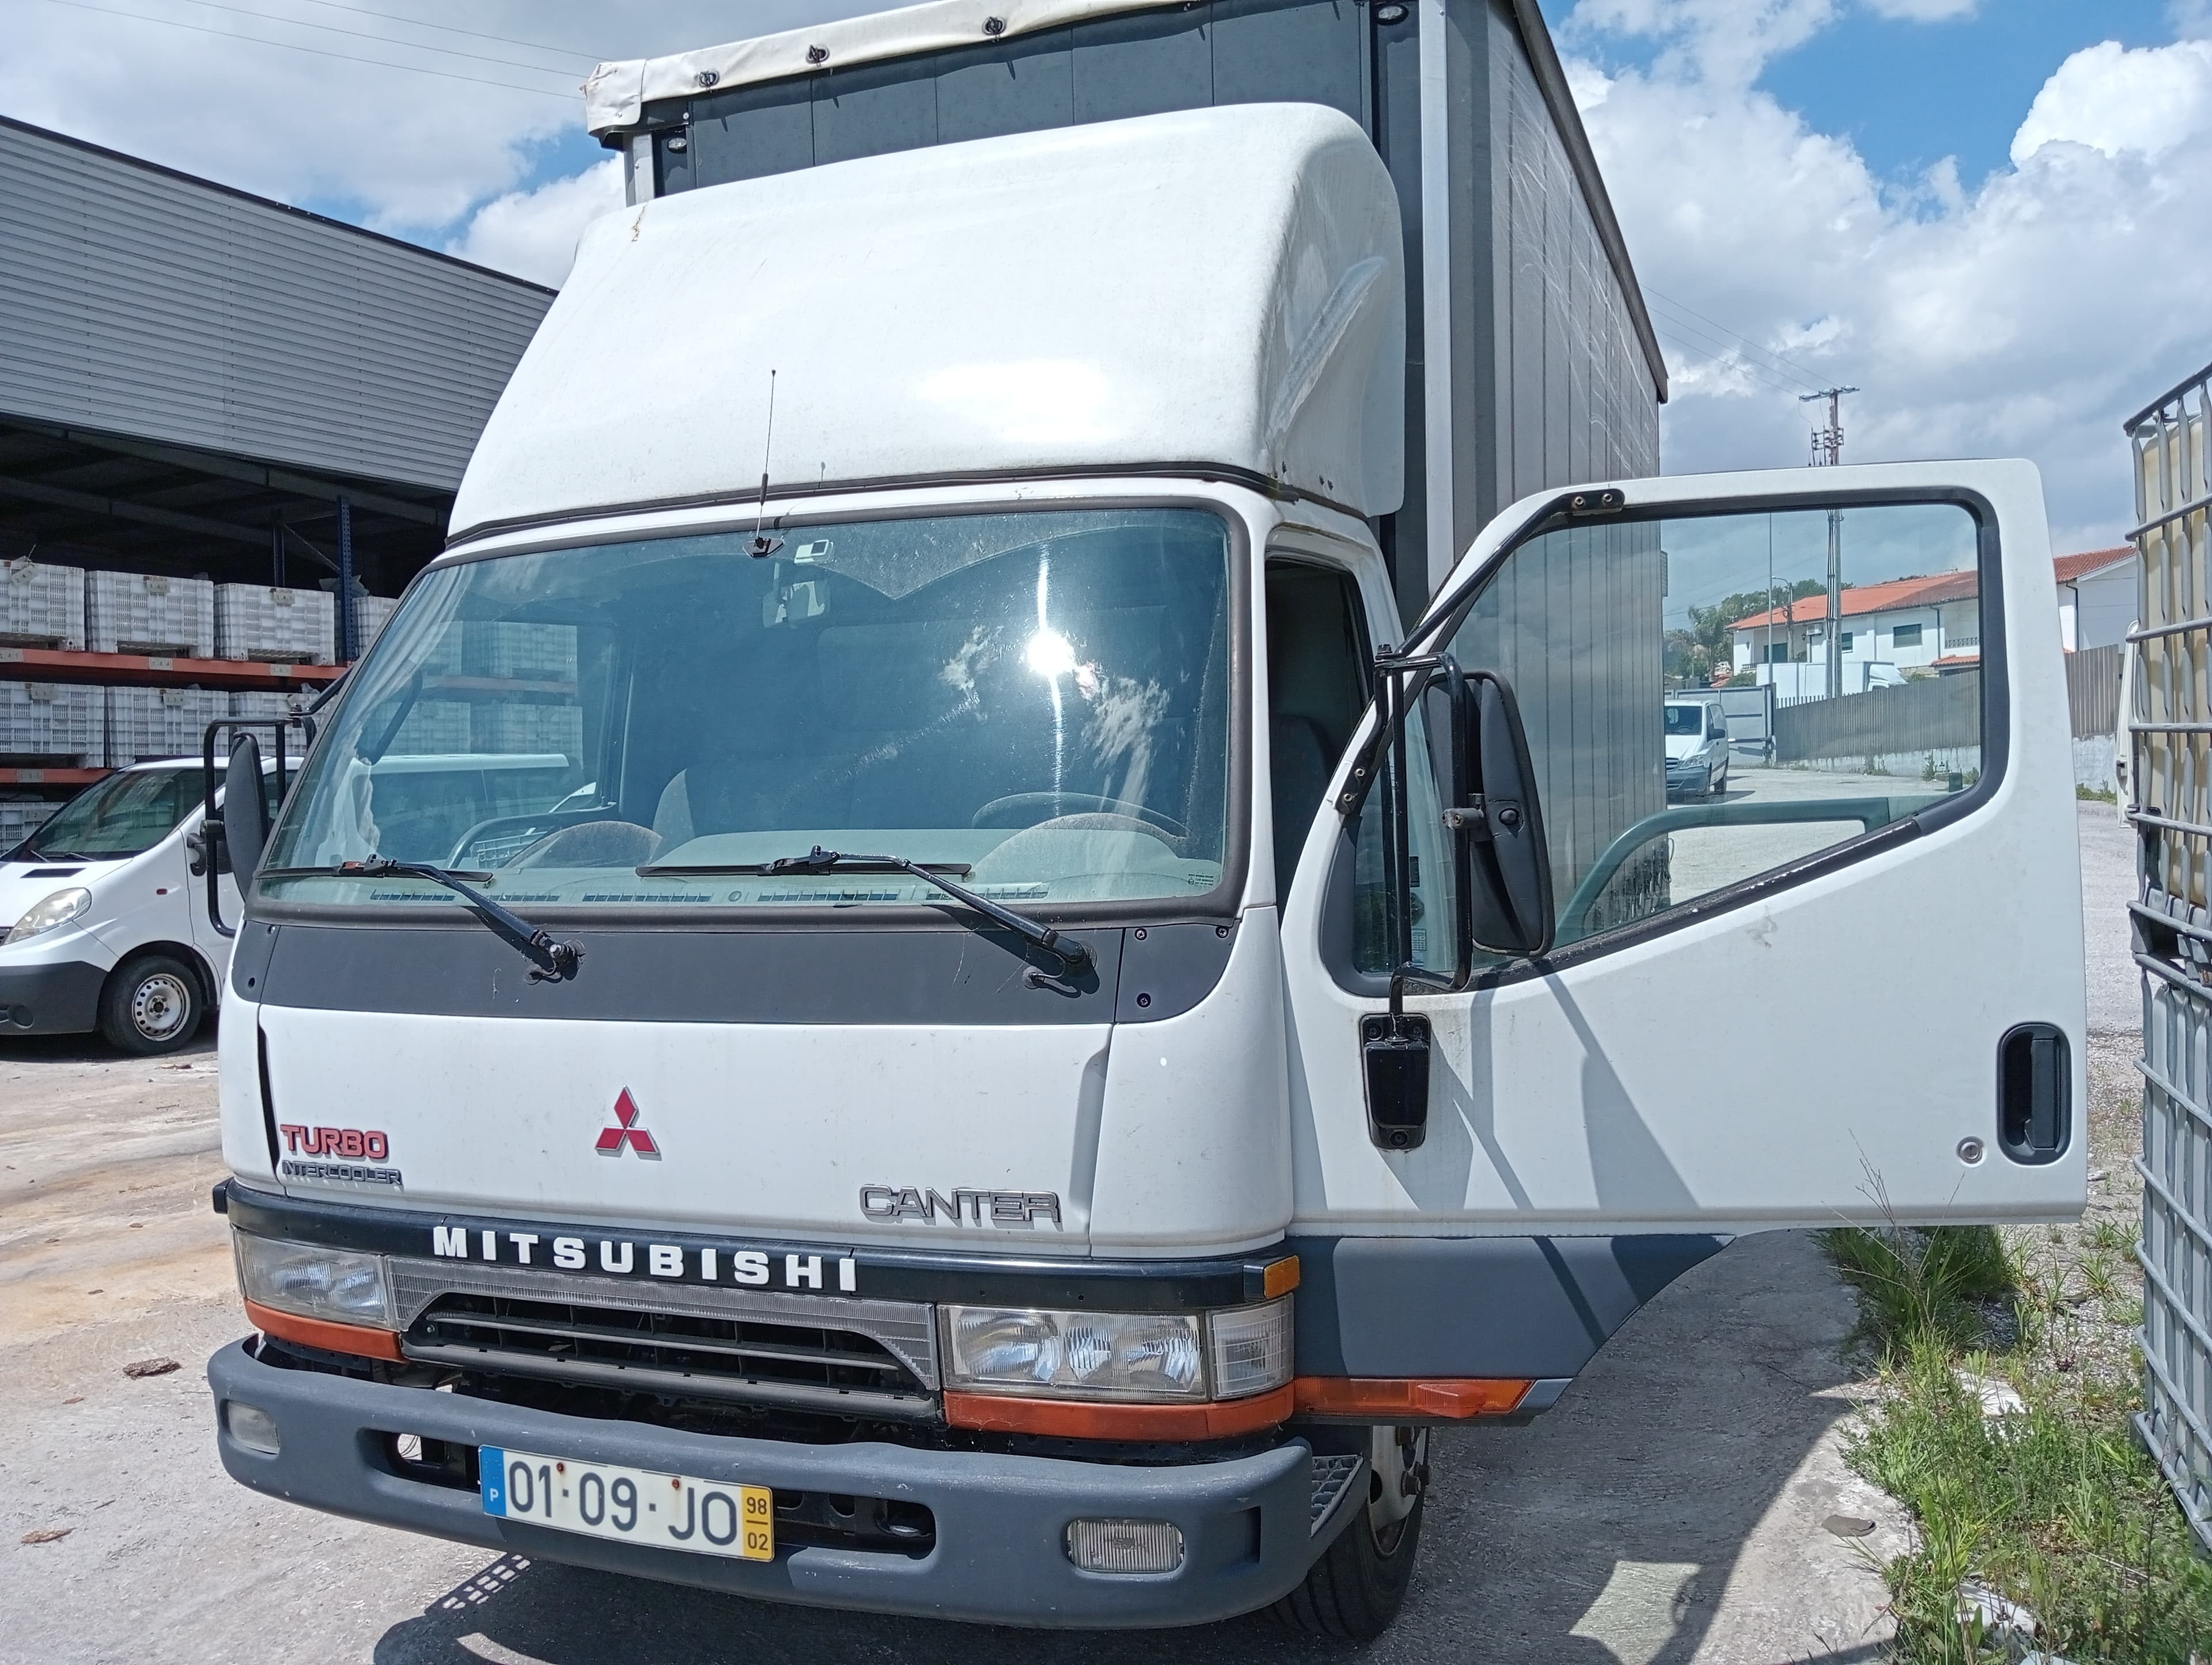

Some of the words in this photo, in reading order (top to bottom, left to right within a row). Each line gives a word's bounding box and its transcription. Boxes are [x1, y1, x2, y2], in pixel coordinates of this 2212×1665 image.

[280, 1124, 388, 1159] TURBO
[281, 1160, 403, 1185] INTERCOOLER
[859, 1184, 1061, 1223] CANTER
[433, 1226, 857, 1292] MITSUBISHI
[490, 1488, 499, 1501] P
[746, 1496, 768, 1515] 98
[747, 1531, 769, 1551] 02
